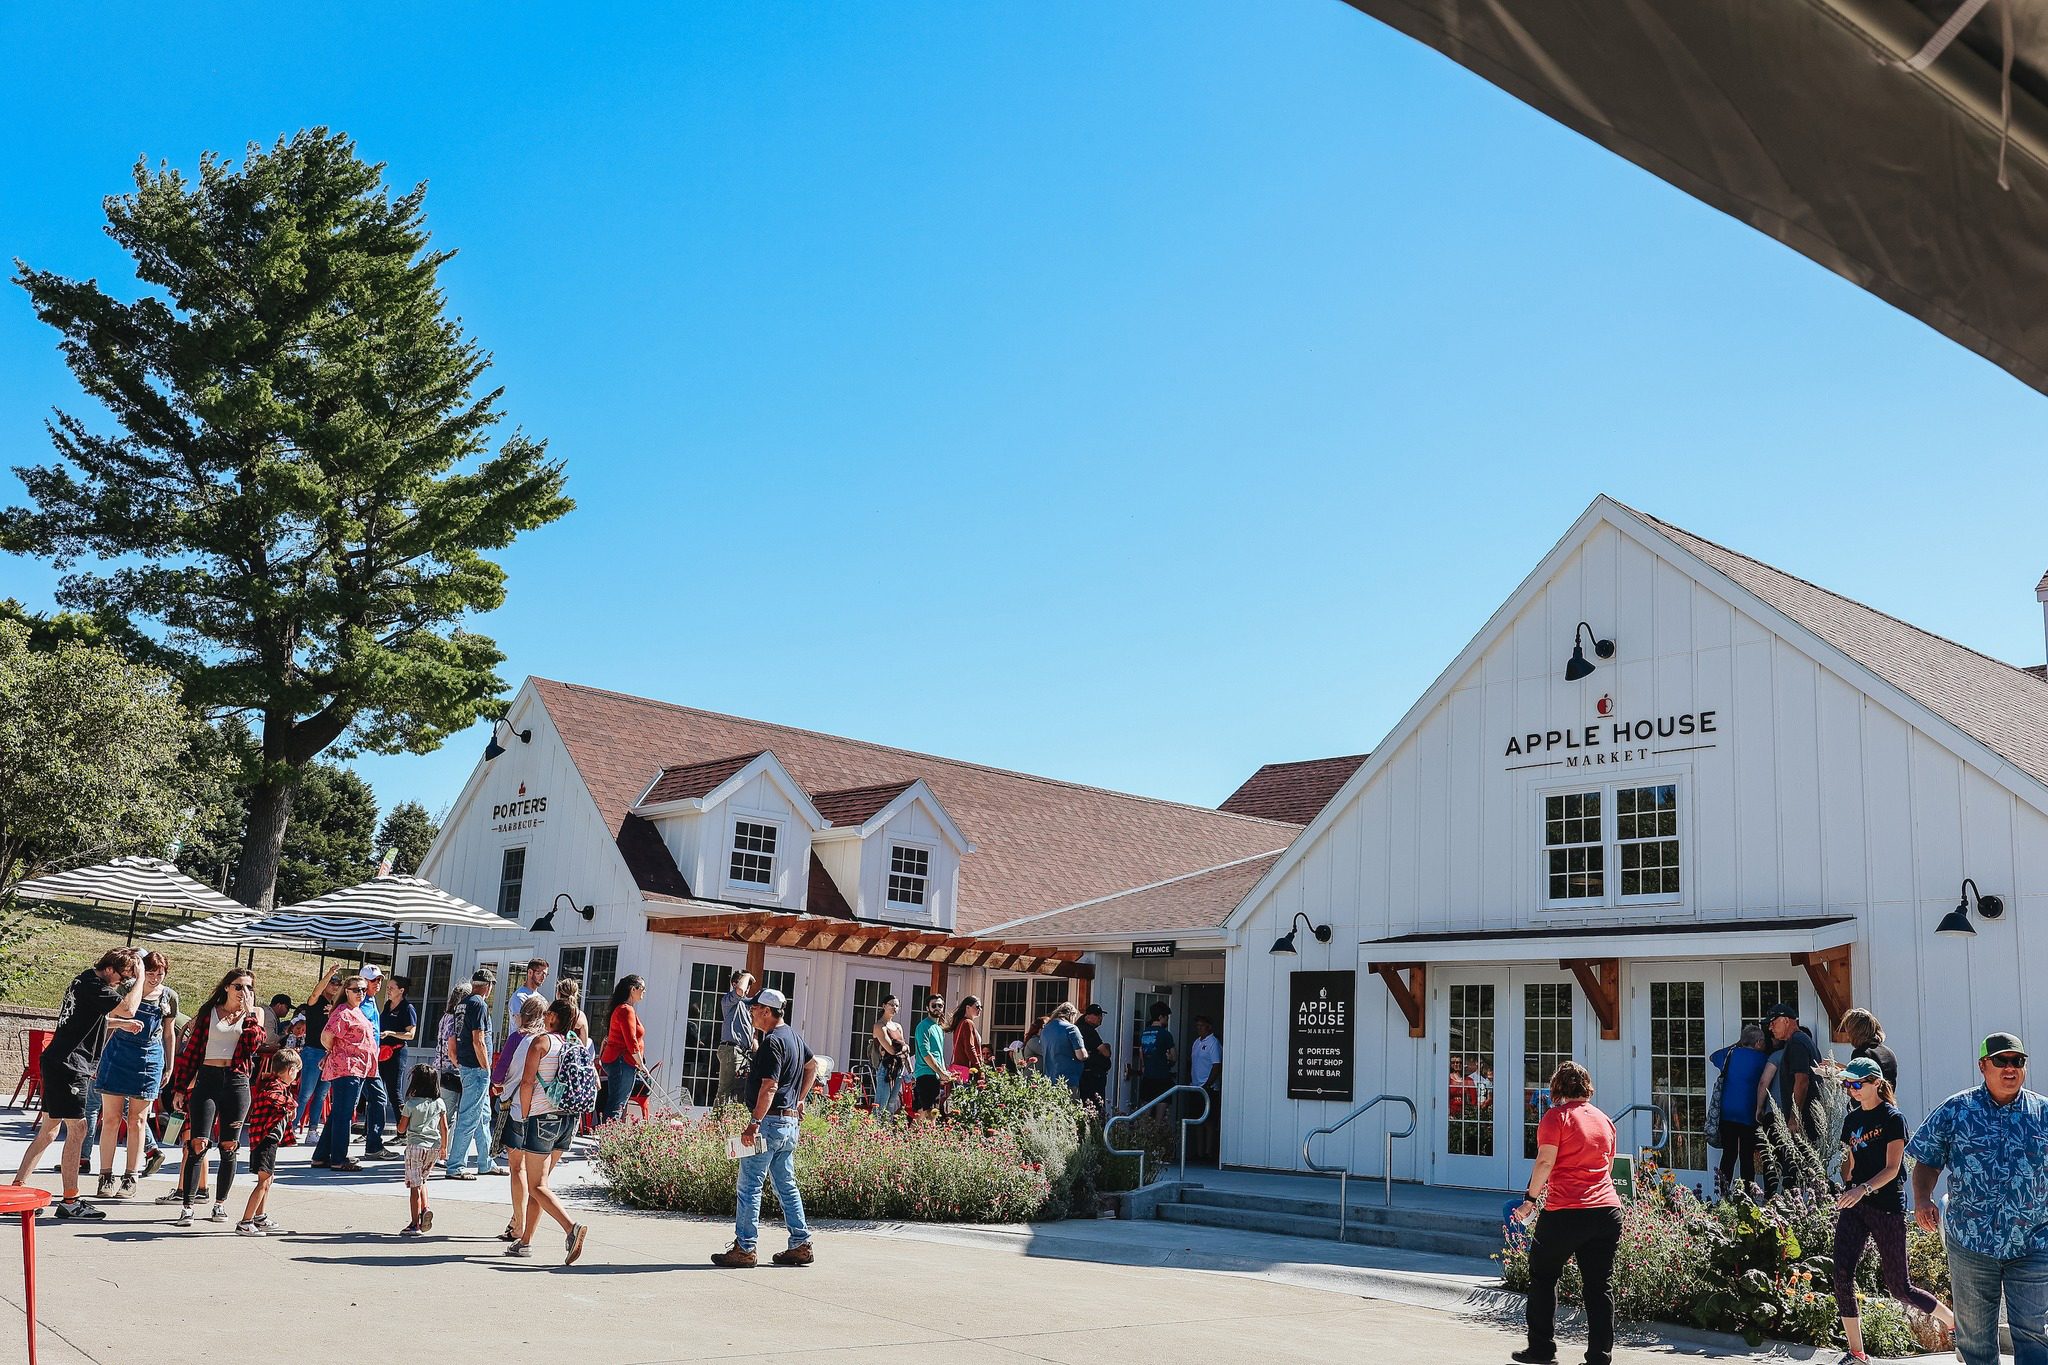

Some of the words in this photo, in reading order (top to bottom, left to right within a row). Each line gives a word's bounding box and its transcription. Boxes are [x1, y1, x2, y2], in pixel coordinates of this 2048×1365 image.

[1505, 725, 1600, 756] APPLE
[1613, 711, 1717, 743] HOUSE
[1566, 748, 1648, 768] MARKET
[498, 819, 538, 832] BARBECUE
[1135, 946, 1170, 954] ENTRANCE
[1298, 1001, 1345, 1013] APPLE
[1298, 1014, 1345, 1025] HOUSE
[1306, 1047, 1341, 1055] PORTER'S
[1306, 1058, 1323, 1066] GIFT
[1323, 1058, 1344, 1066] SHOP
[1306, 1069, 1325, 1077] WINE
[1325, 1069, 1341, 1077] BAR
